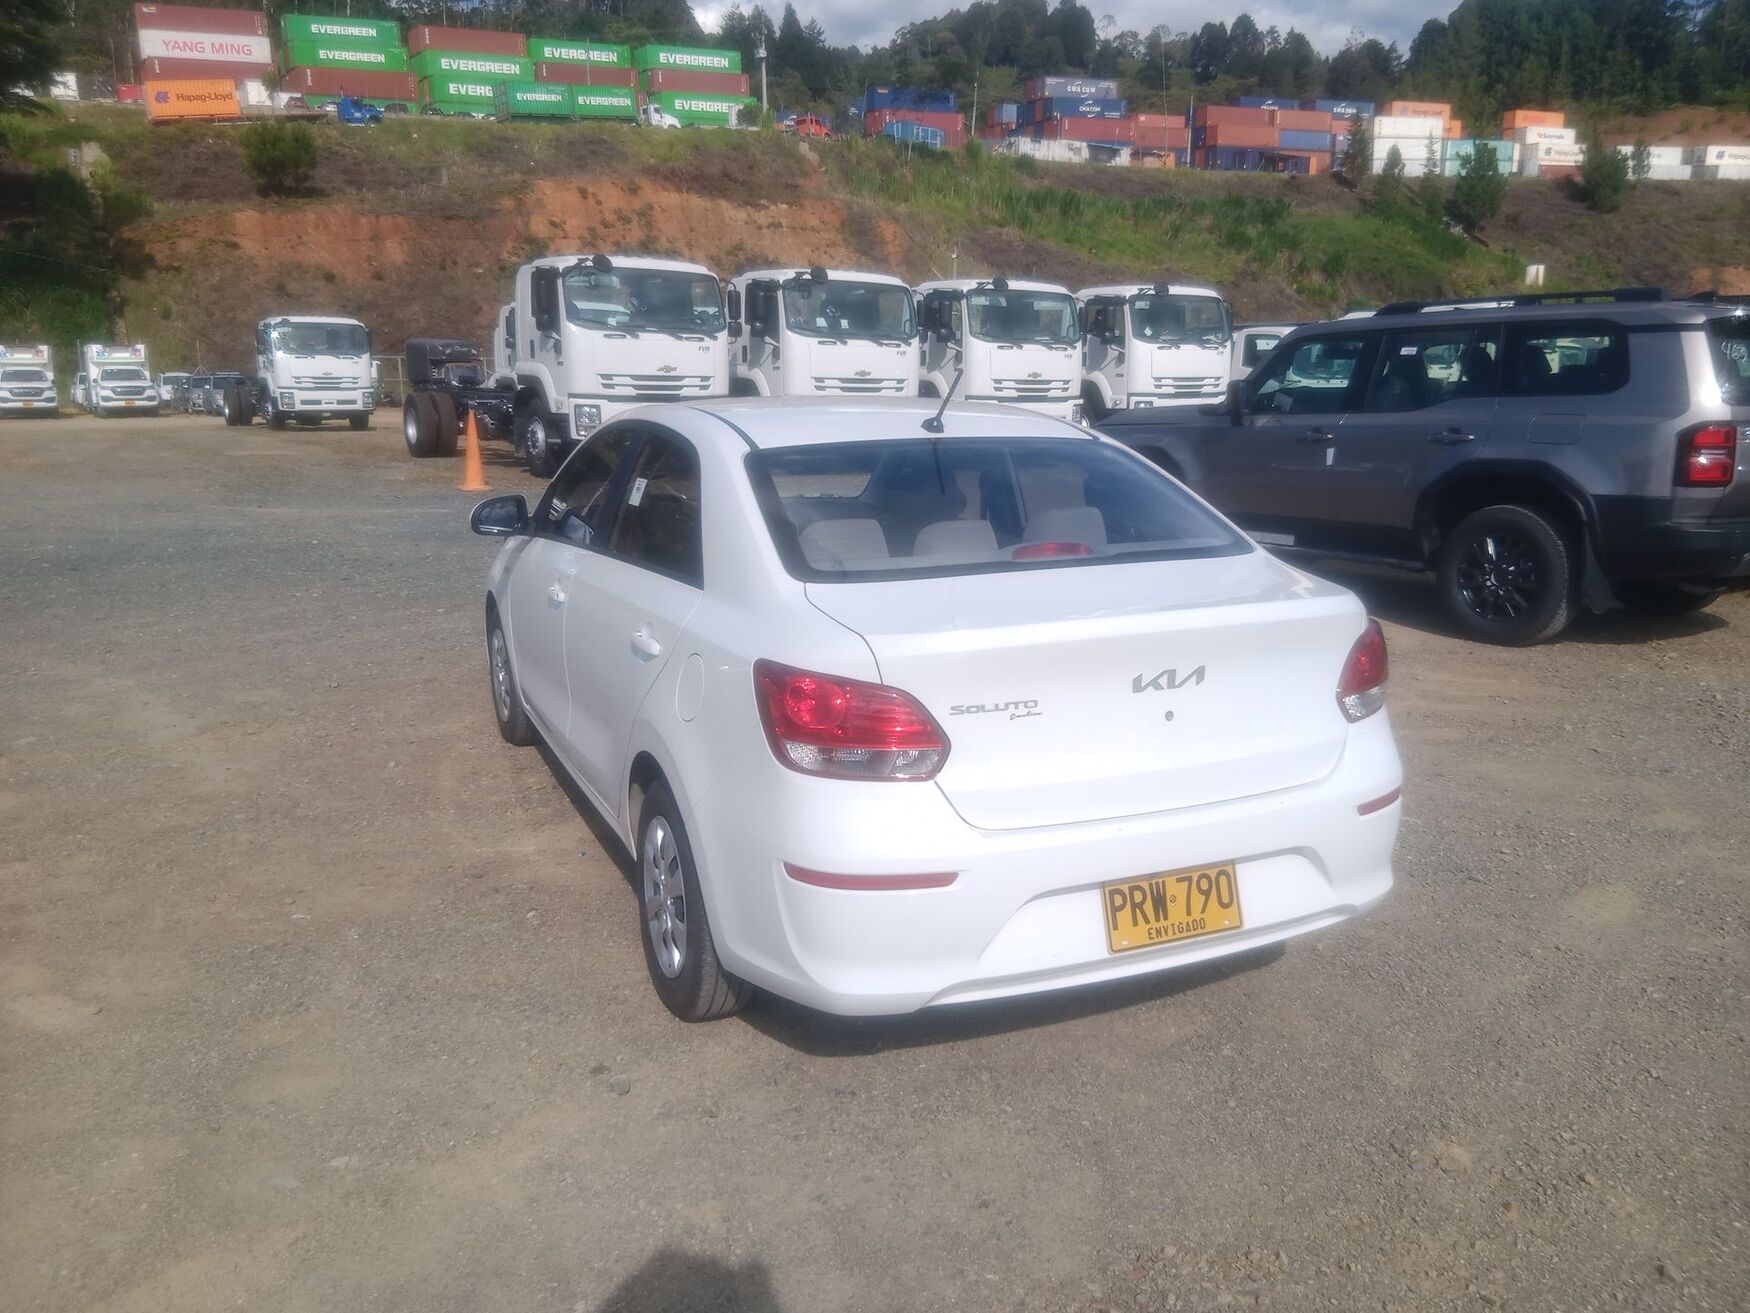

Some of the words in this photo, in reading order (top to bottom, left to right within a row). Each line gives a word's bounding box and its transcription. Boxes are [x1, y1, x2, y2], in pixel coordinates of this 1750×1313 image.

[311, 23, 377, 37] EVERGREEN
[161, 39, 206, 53] YANG
[211, 42, 252, 56] MING
[544, 47, 618, 62] EVERGREEN
[319, 49, 386, 63] EVERGREEN
[660, 52, 729, 68] EVERGREEN
[440, 58, 520, 74] EVERGREEN
[176, 92, 234, 102] Hapag-Lloyd
[448, 83, 494, 97] EVERG
[516, 93, 562, 102] EVERGREEN
[578, 96, 632, 106] EVERGREEN
[675, 99, 731, 113] EVERGRE
[1132, 665, 1205, 693] KIA
[949, 699, 1038, 716] SOLUTO
[1108, 880, 1169, 931] PRW
[1175, 869, 1234, 917] 790
[1147, 917, 1206, 940] ENVIGADO
